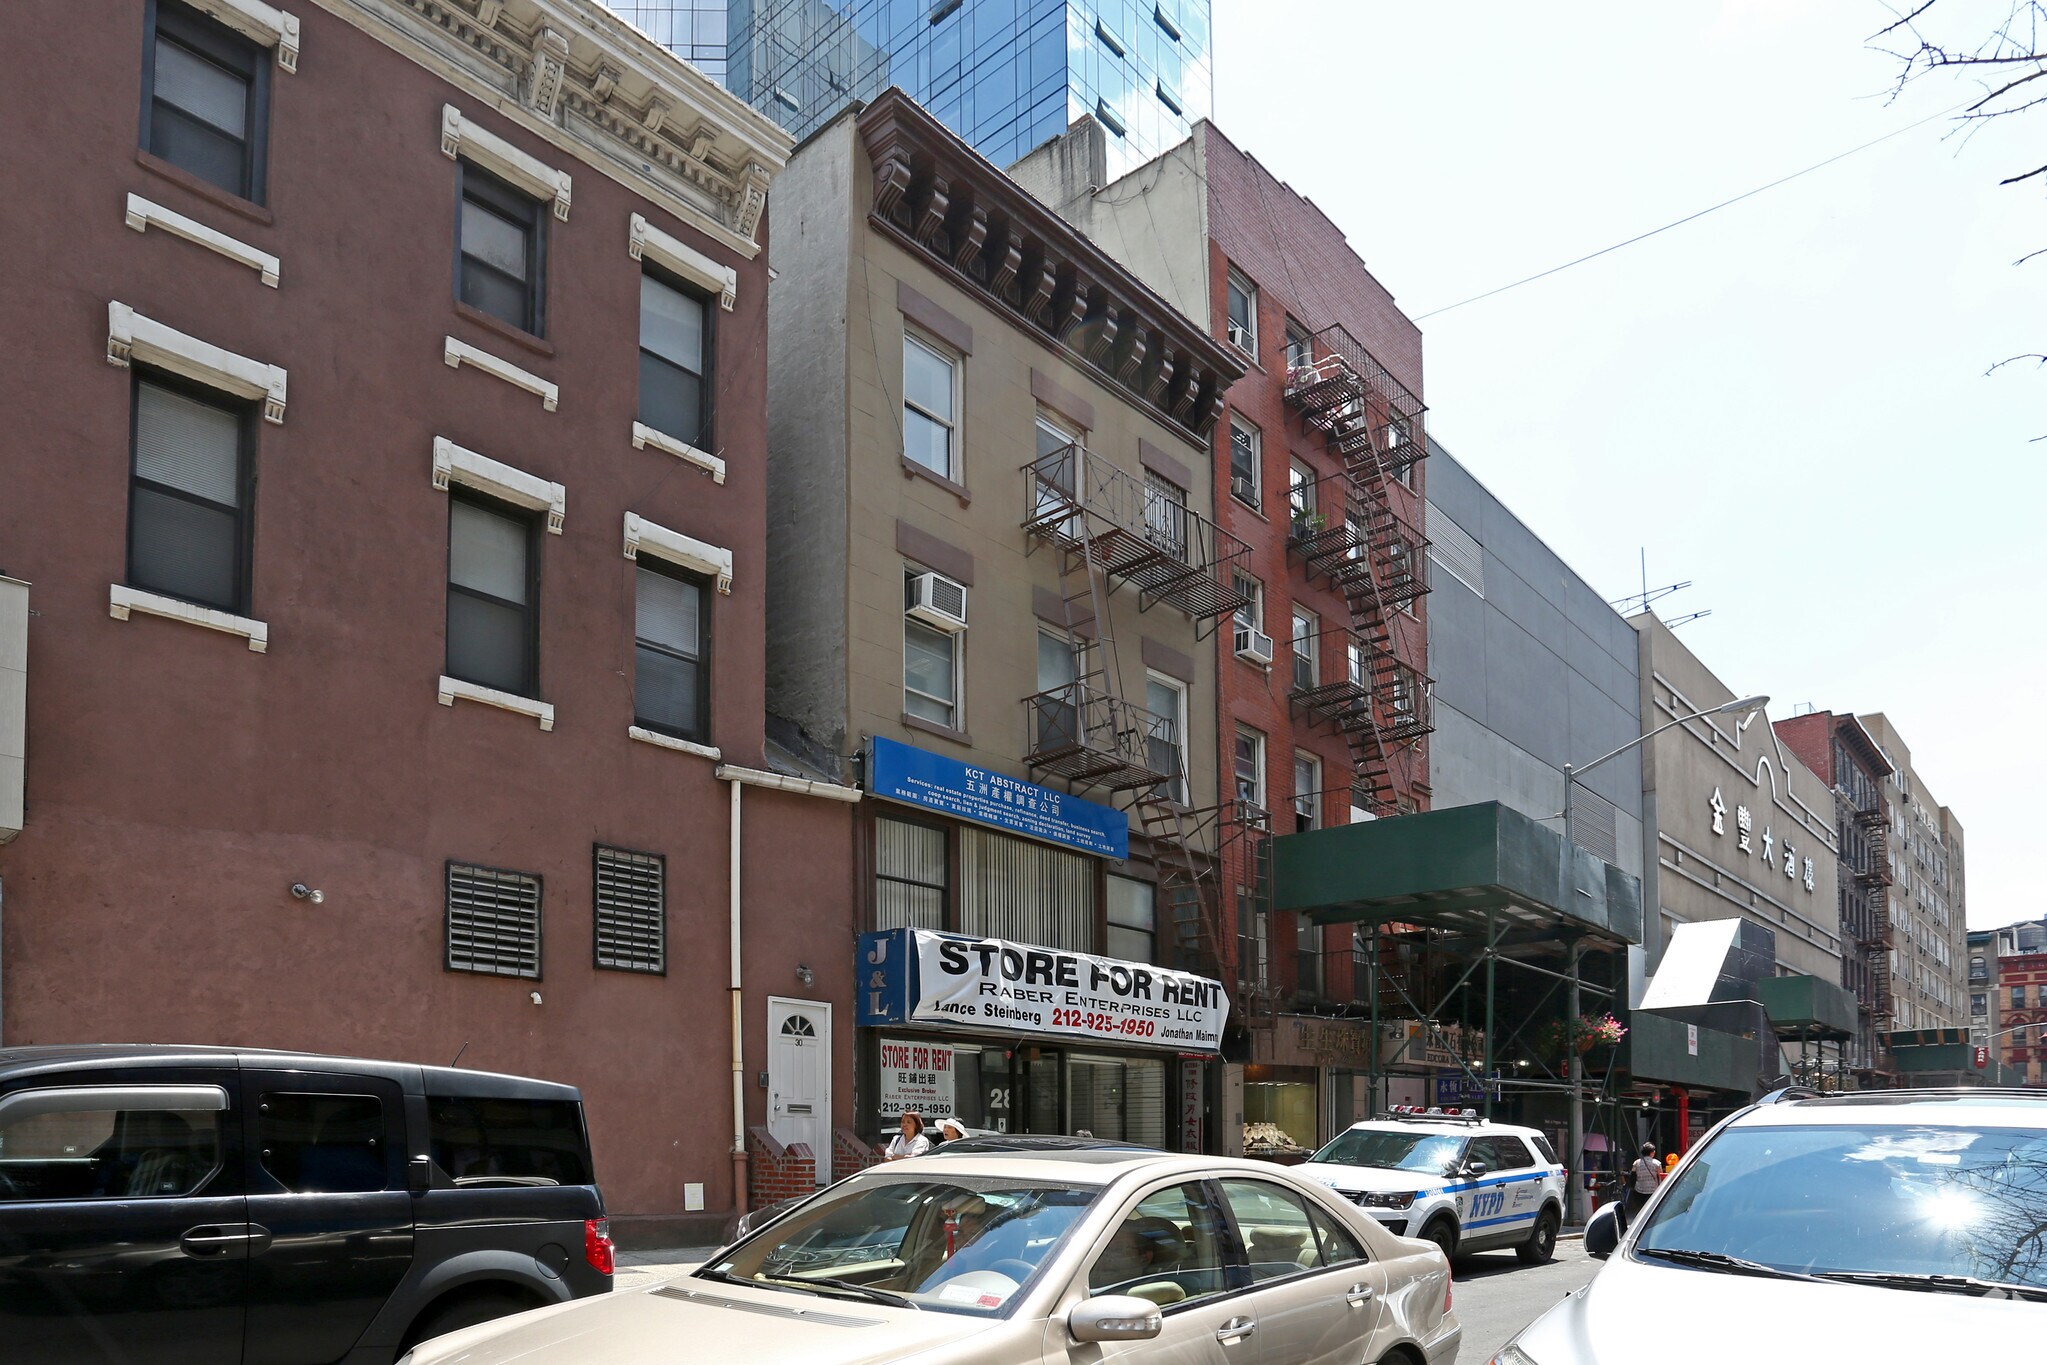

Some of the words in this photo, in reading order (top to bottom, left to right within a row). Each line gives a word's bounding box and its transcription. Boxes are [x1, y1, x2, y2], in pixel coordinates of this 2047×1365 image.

[965, 767, 984, 780] KCT
[990, 776, 1039, 797] ABSTRACT
[1044, 791, 1060, 803] LLC
[966, 779, 1060, 816] 五洲產權調查公司
[907, 776, 933, 789] Services:
[946, 788, 962, 797] estate
[963, 792, 989, 804] properties
[1039, 814, 1051, 822] deed
[1071, 823, 1090, 833] business
[928, 790, 941, 799] coop
[942, 794, 961, 804] search,
[963, 798, 973, 807] lien
[978, 804, 1002, 815] judgment
[1022, 816, 1037, 826] zoning
[1076, 830, 1091, 840] survey
[867, 938, 889, 965] J
[870, 970, 887, 989] &
[939, 940, 1079, 988] STORE
[1090, 963, 1153, 1000] FOR
[1161, 974, 1222, 1010] RENT
[868, 991, 889, 1016] L
[979, 982, 1054, 1004] RABER
[1065, 991, 1170, 1019] ENTERPRISES
[1177, 1009, 1202, 1023] LLC
[934, 1000, 976, 1016] Lance
[984, 1002, 1042, 1025] Steinberg
[1052, 1007, 1155, 1037] 212-925-1950
[1160, 1026, 1194, 1041] Jonathan
[795, 1038, 803, 1047] 30
[882, 1044, 909, 1069] STORE
[913, 1047, 929, 1070] FOR
[932, 1048, 953, 1072] RENT
[898, 1086, 920, 1094] Exclusive
[921, 1087, 937, 1095] Broker
[882, 1102, 951, 1114] 212-925-1950
[1469, 1191, 1505, 1218] NYPD
